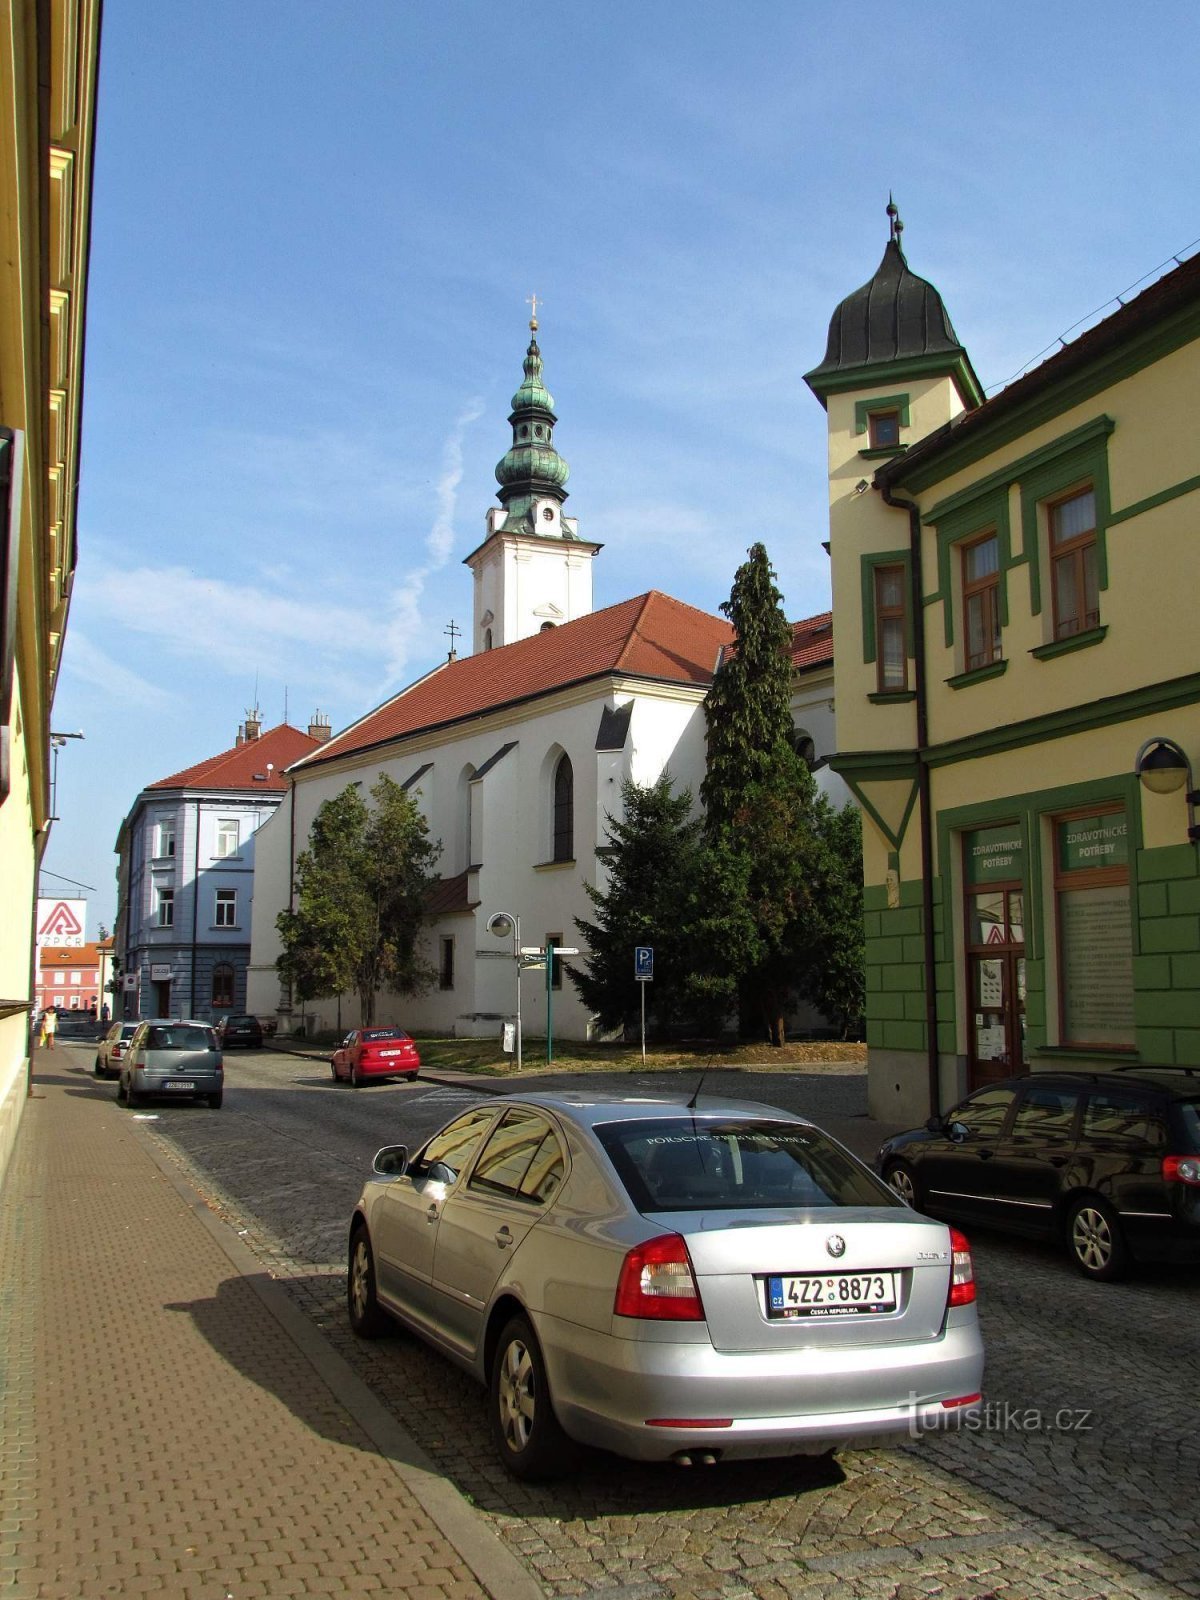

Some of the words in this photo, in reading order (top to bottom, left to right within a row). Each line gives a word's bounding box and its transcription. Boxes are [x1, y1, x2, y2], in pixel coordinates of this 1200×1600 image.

[1066, 824, 1128, 843] ZDRAVOTNICKÉ
[972, 840, 1023, 856] ZDRAVOTNICKÉ
[1079, 843, 1116, 857] POTŘEBY
[982, 856, 1013, 868] POTŘEBY
[65, 936, 82, 947] ČR
[640, 950, 650, 965] P
[646, 1135, 712, 1145] PORSCHE
[788, 1279, 824, 1304] 4Z2
[838, 1276, 885, 1301] 8873
[773, 1297, 783, 1305] CZ
[810, 1308, 829, 1316] ČESKÁ
[829, 1307, 859, 1315] REPUBLIKA
